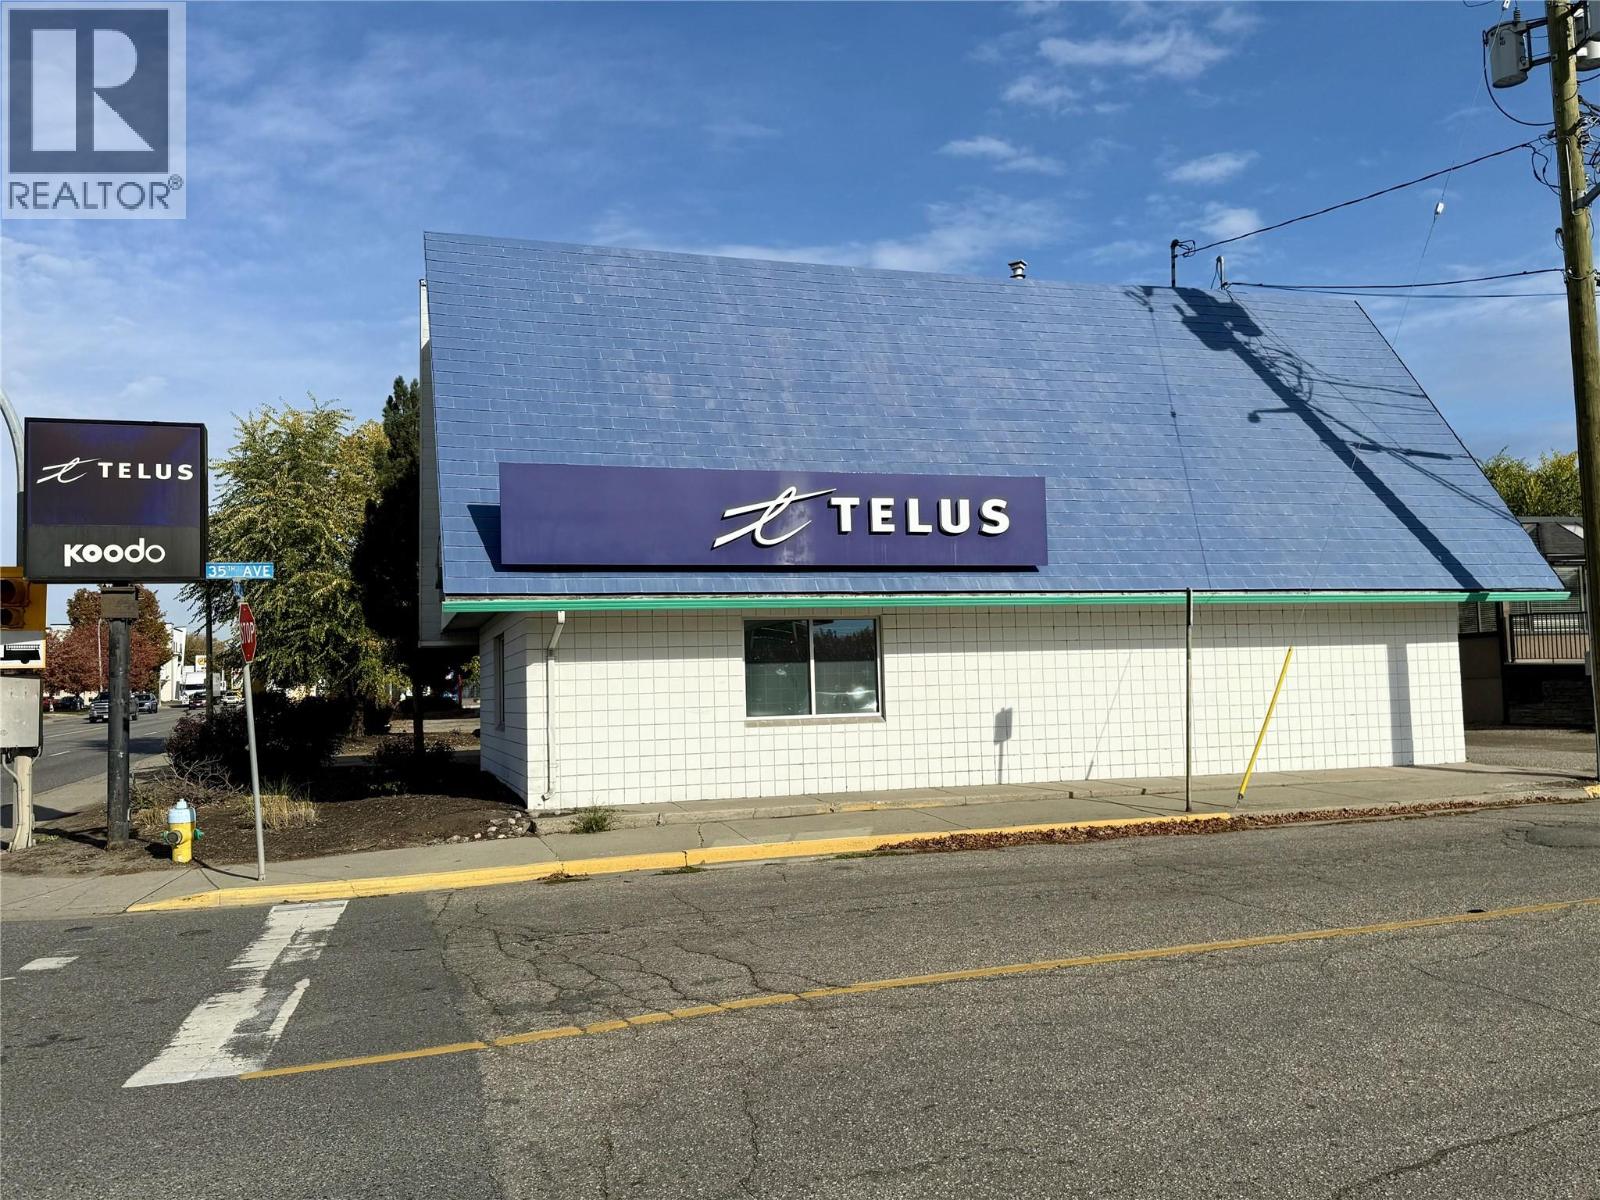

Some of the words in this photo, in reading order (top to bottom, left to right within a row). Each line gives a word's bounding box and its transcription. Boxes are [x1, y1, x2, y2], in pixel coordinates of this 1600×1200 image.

[98, 462, 194, 481] TELUS
[830, 497, 1011, 535] TELUS
[243, 565, 271, 577] AVE
[241, 622, 255, 643] STOP
